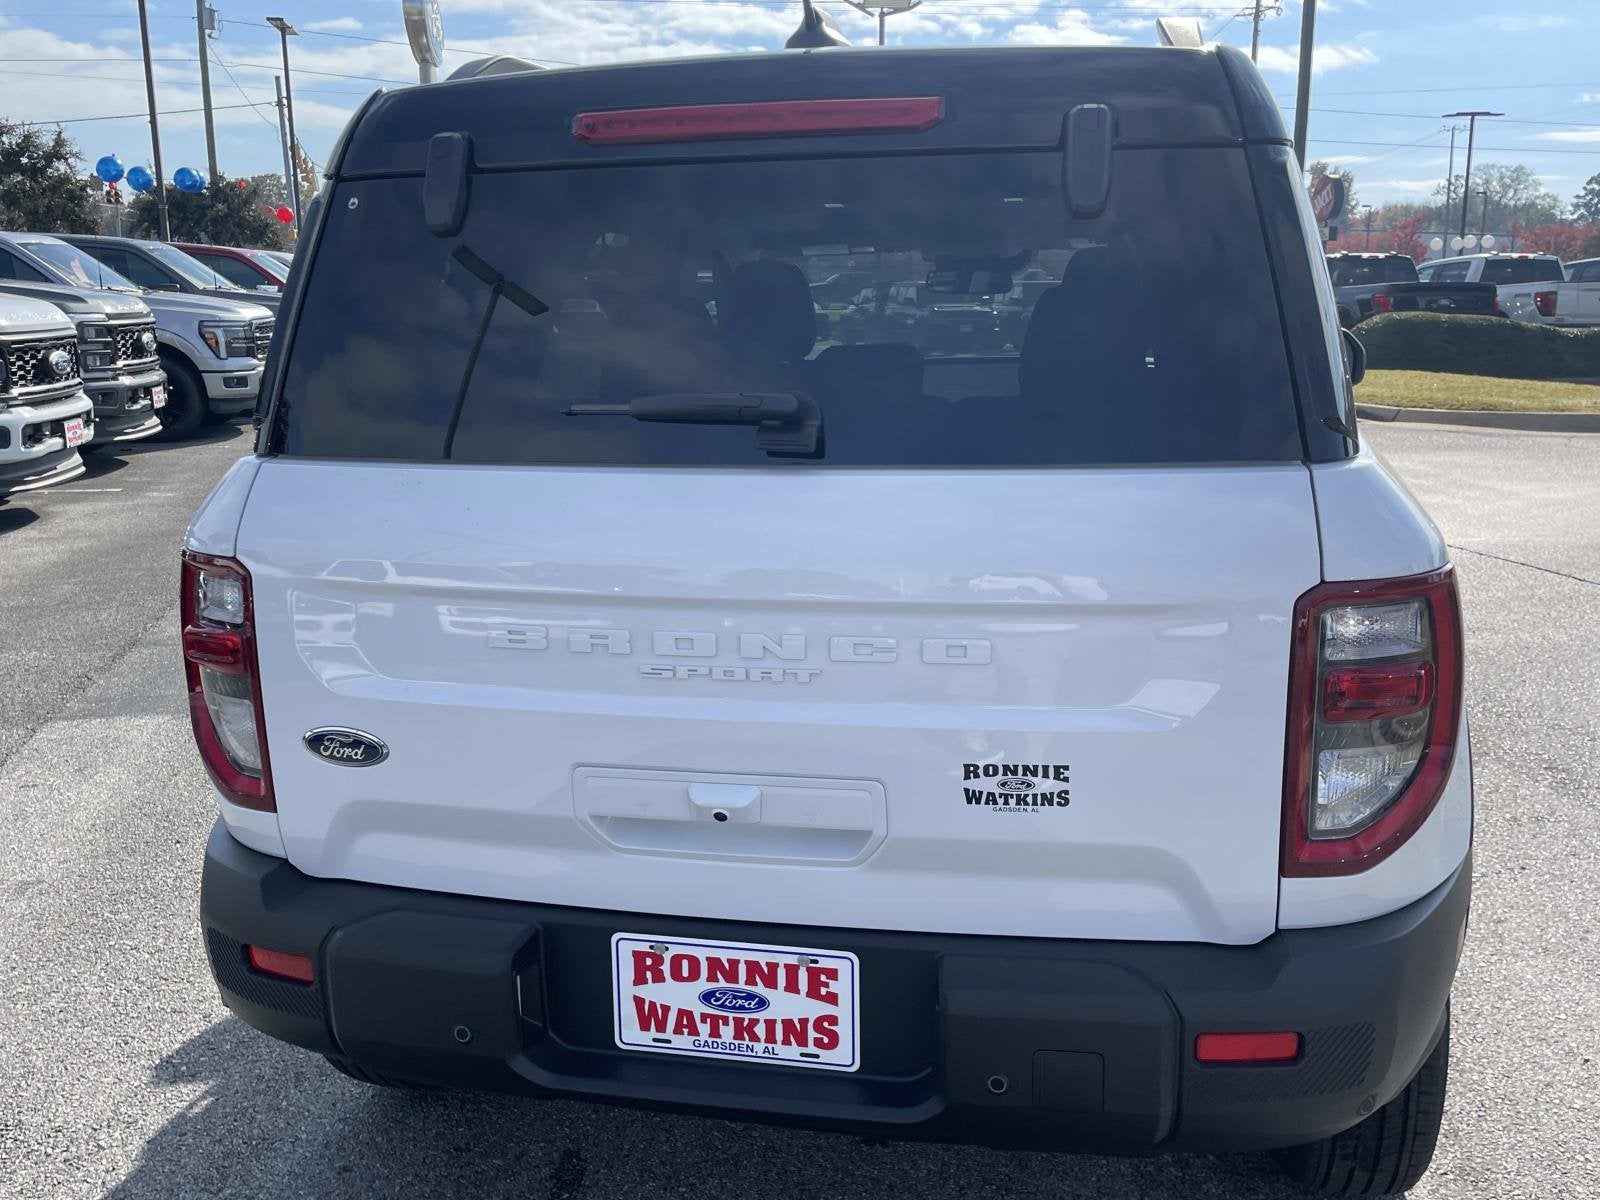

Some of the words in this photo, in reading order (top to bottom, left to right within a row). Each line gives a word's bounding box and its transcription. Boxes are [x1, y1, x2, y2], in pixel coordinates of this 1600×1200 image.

[488, 625, 992, 665] BRONCO
[640, 665, 822, 683] SPORT
[320, 735, 366, 760] Ford
[963, 763, 1070, 783] RONNIE
[963, 787, 1070, 807] WATKINS
[632, 950, 839, 1007] RONNIE
[710, 992, 758, 1011] Ford
[632, 994, 840, 1051] WATKINS
[692, 1038, 758, 1055] GADSDEN,
[761, 1046, 780, 1057] AL
